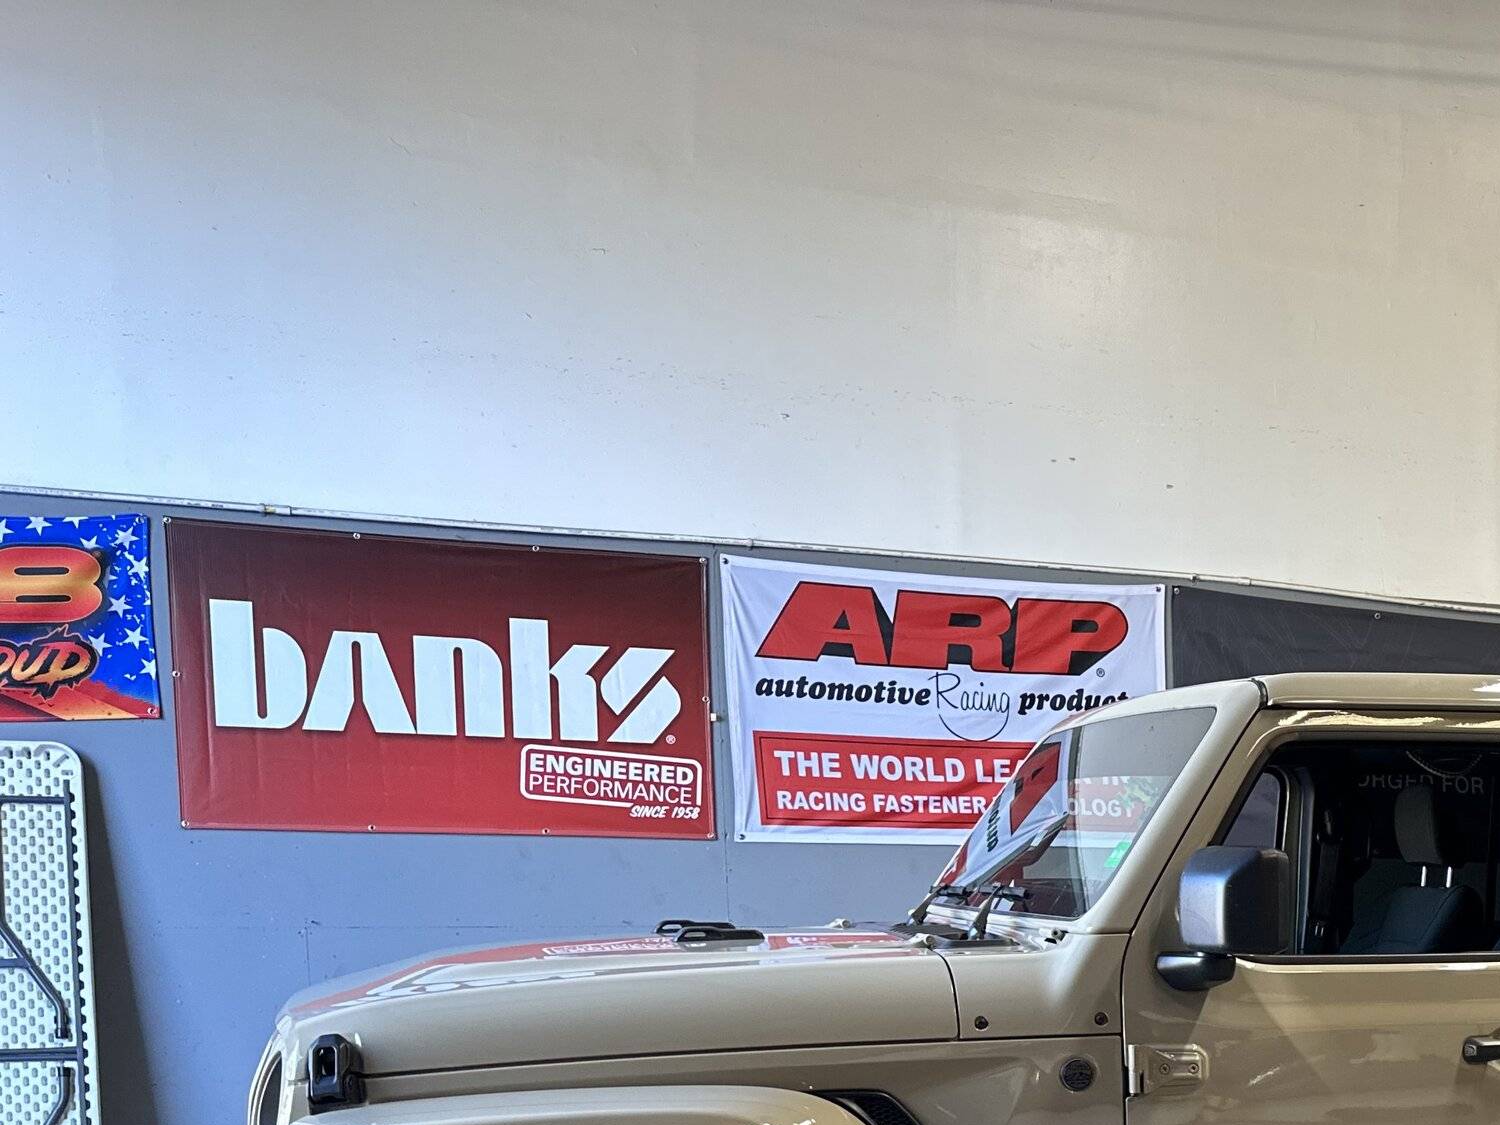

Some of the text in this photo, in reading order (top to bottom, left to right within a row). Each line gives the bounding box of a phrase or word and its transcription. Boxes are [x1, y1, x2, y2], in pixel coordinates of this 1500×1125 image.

[755, 580, 1129, 677] ARP
[209, 598, 682, 744] banks
[755, 676, 932, 706] automotive
[928, 672, 1010, 741] Racing
[529, 753, 694, 785] ENGINEERED
[773, 750, 842, 779] THE
[850, 753, 966, 783] WORLD
[529, 774, 692, 805] PERFORMANCE
[1441, 775, 1485, 795] FOR
[630, 805, 701, 820] SINCE 1958
[776, 790, 867, 812] RACING
[872, 793, 987, 814] FASTENER
